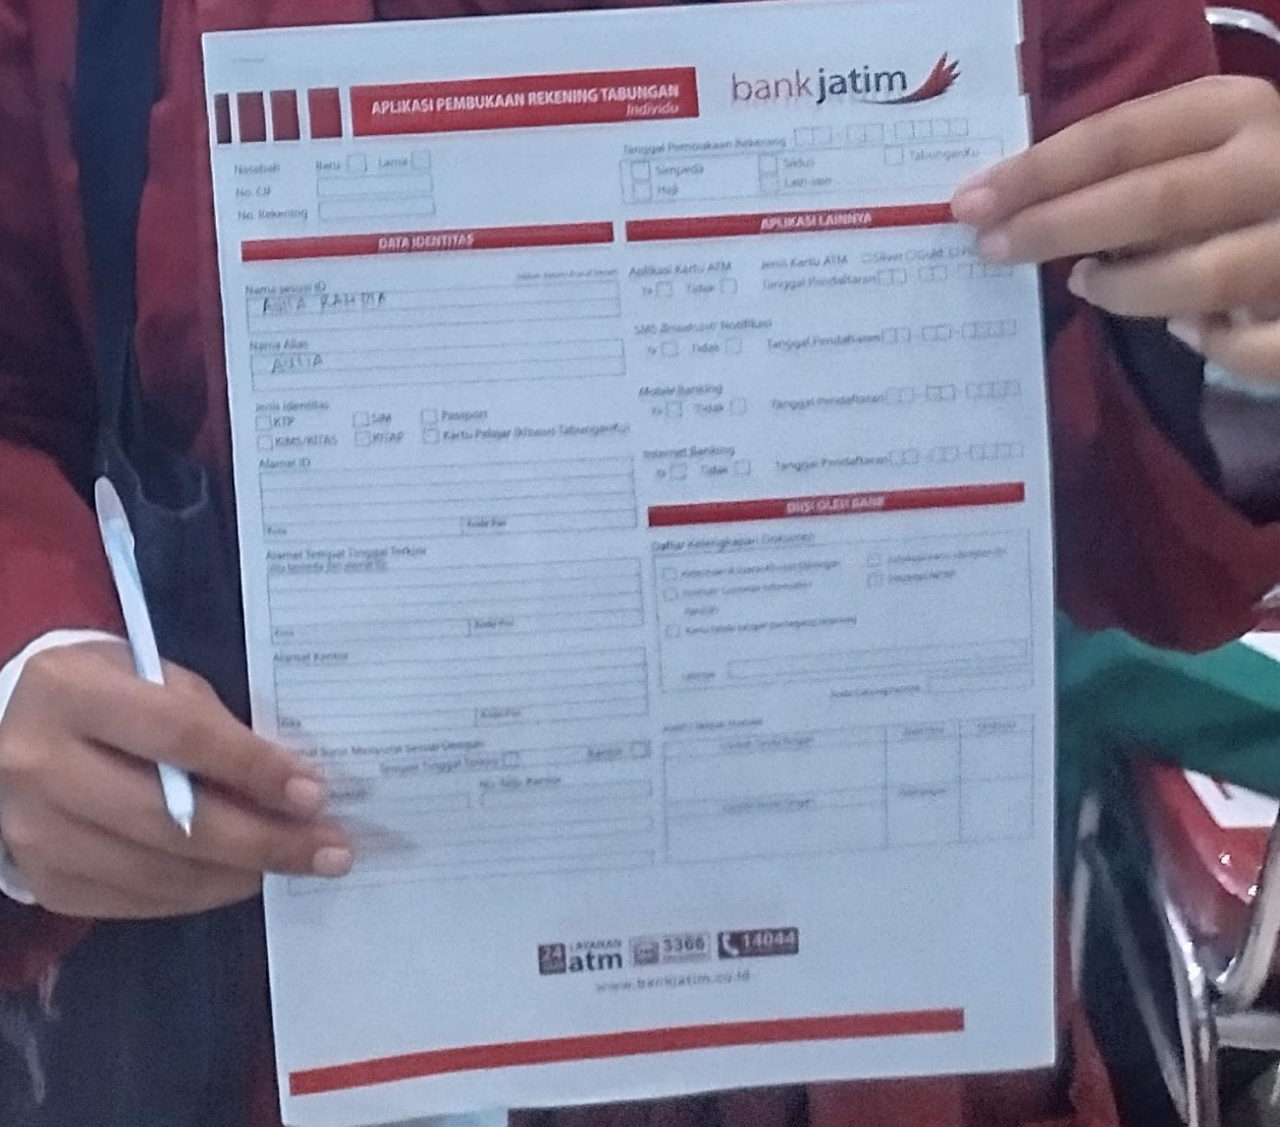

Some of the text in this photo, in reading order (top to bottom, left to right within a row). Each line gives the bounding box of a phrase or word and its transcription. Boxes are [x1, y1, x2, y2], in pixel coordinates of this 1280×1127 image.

[372, 83, 680, 115] APLIKASI PEMBUKAAN REKENING TABUNGAN
[626, 102, 680, 117] Individu
[761, 211, 872, 230] APLIKASI LAINNYA
[378, 232, 475, 250] DATA IDENTITAS
[741, 930, 797, 948] 14044
[569, 951, 623, 973] atm
